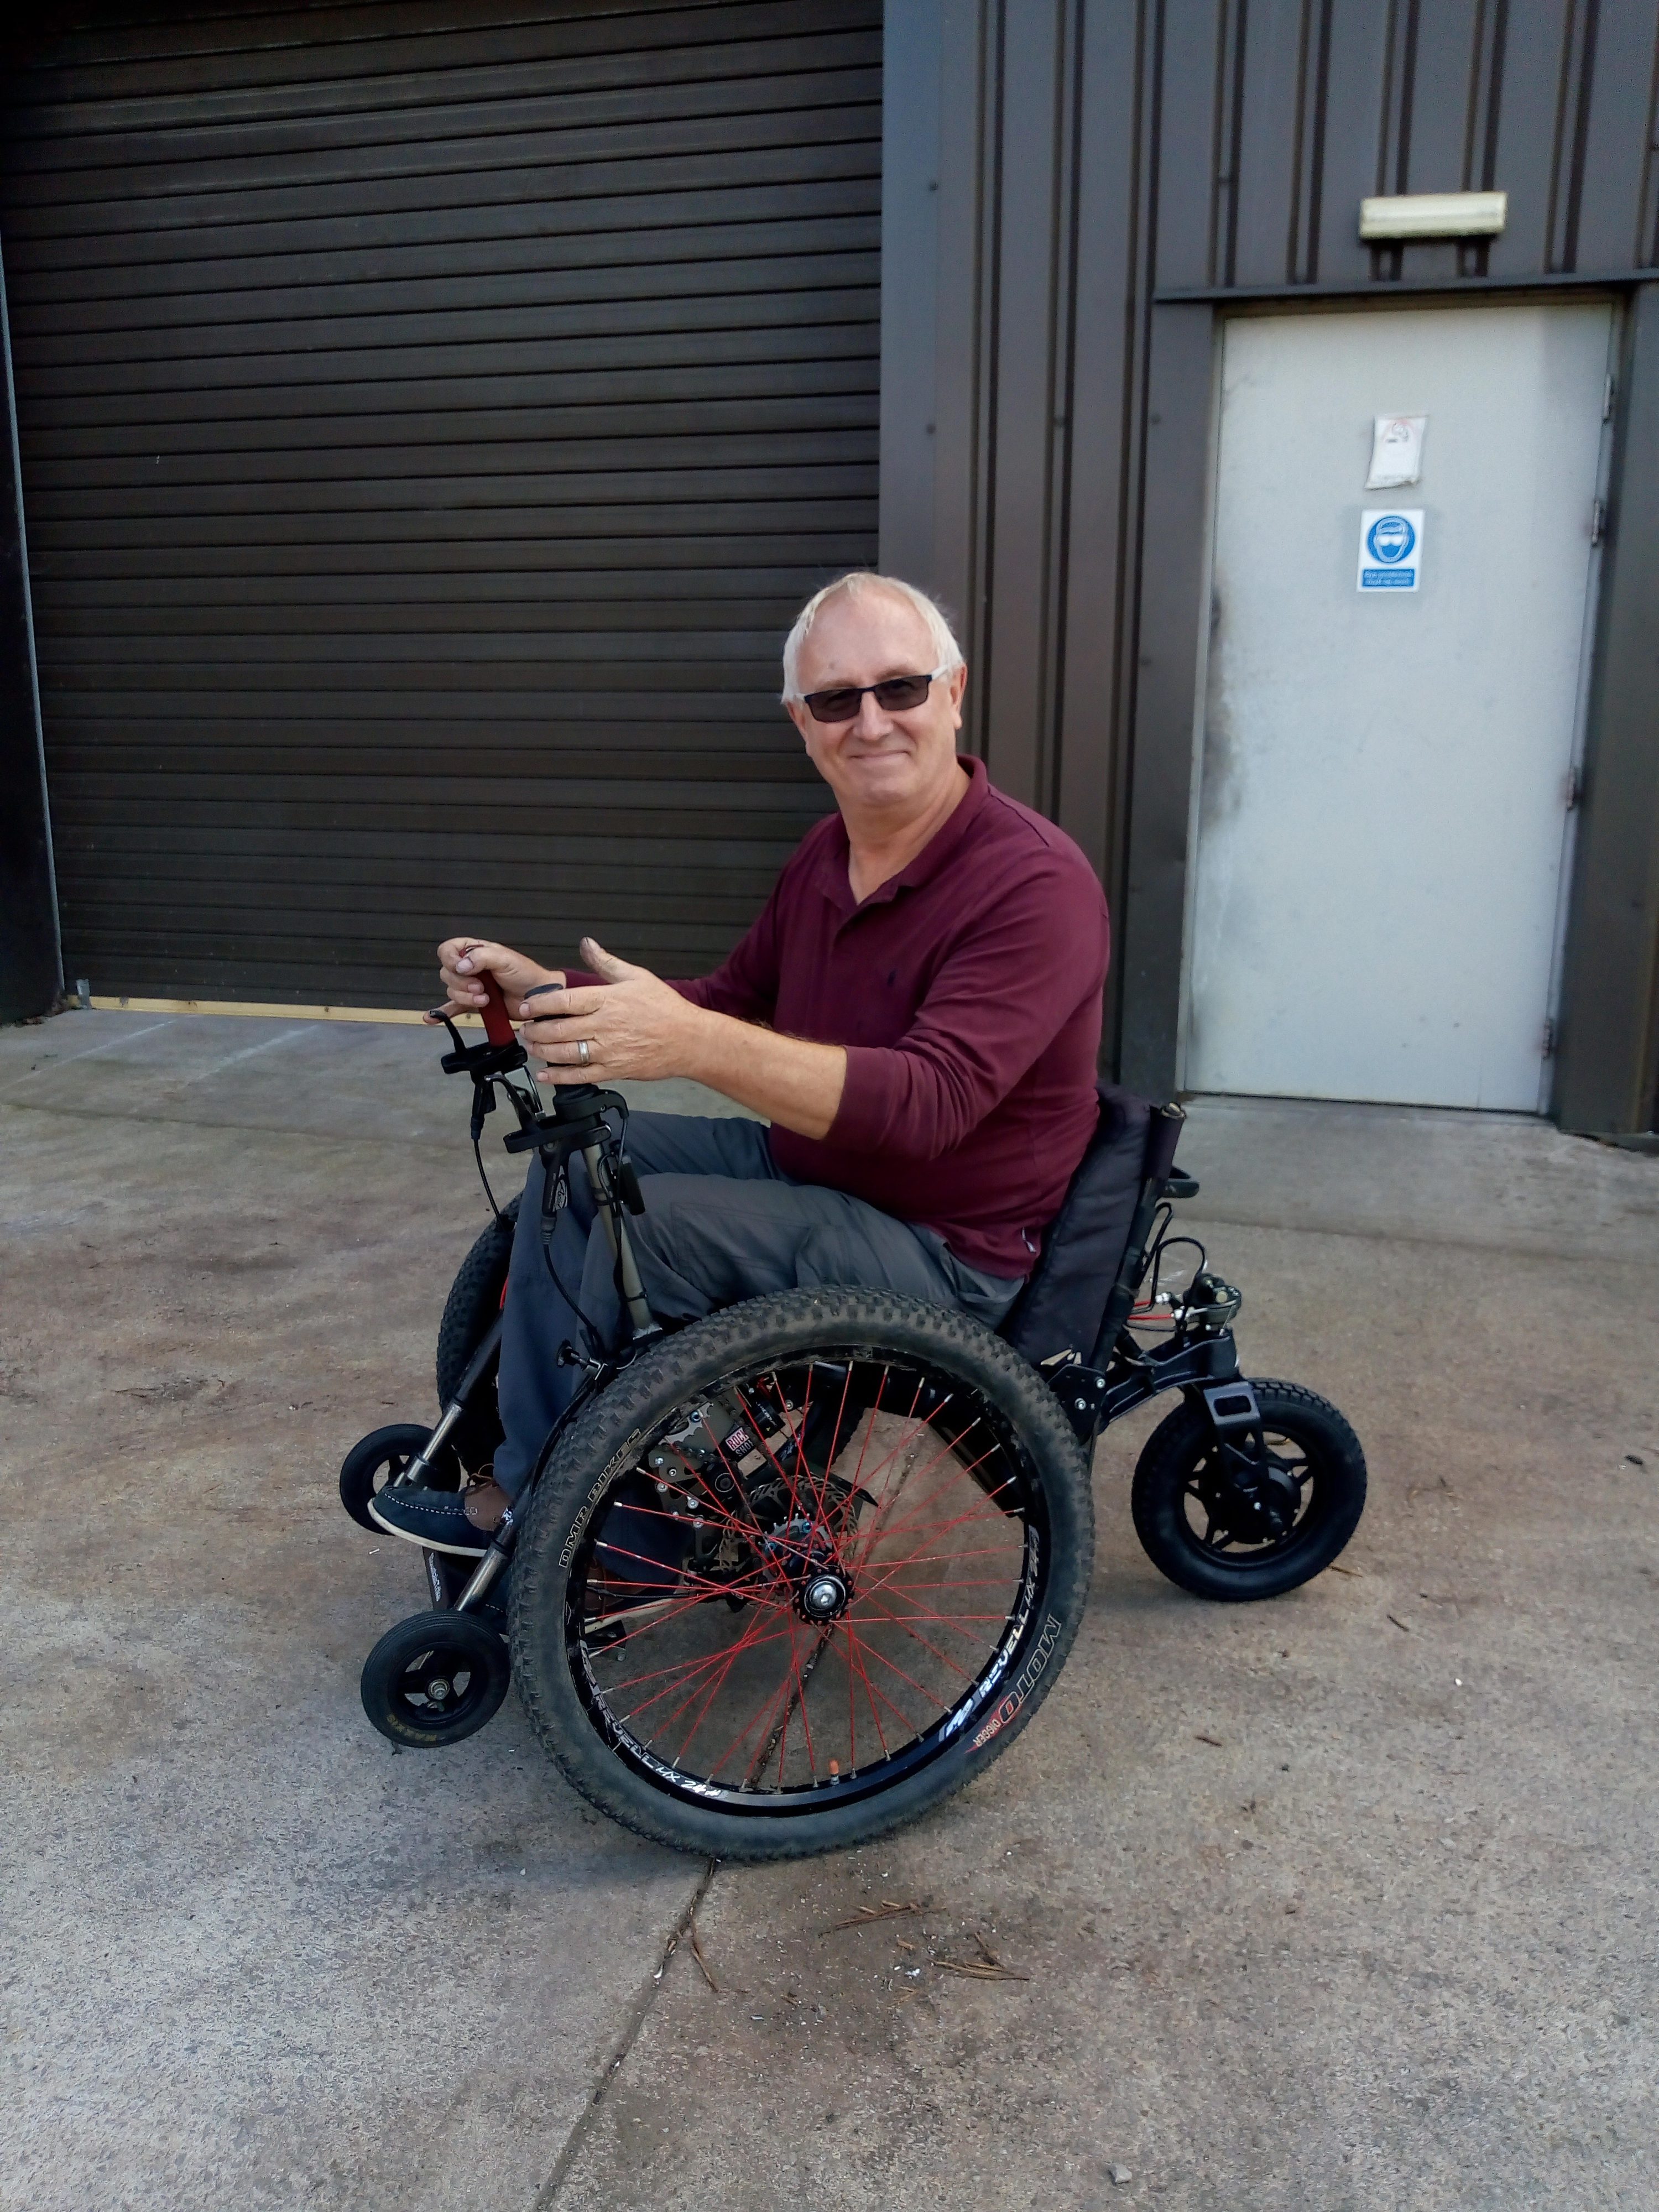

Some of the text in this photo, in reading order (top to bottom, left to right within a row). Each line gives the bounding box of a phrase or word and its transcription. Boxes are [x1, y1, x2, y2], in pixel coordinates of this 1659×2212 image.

[559, 1428, 641, 1568] DMR BIKES
[973, 1614, 1062, 1747] MOTO DIGGER
[655, 1767, 681, 1782] MX
